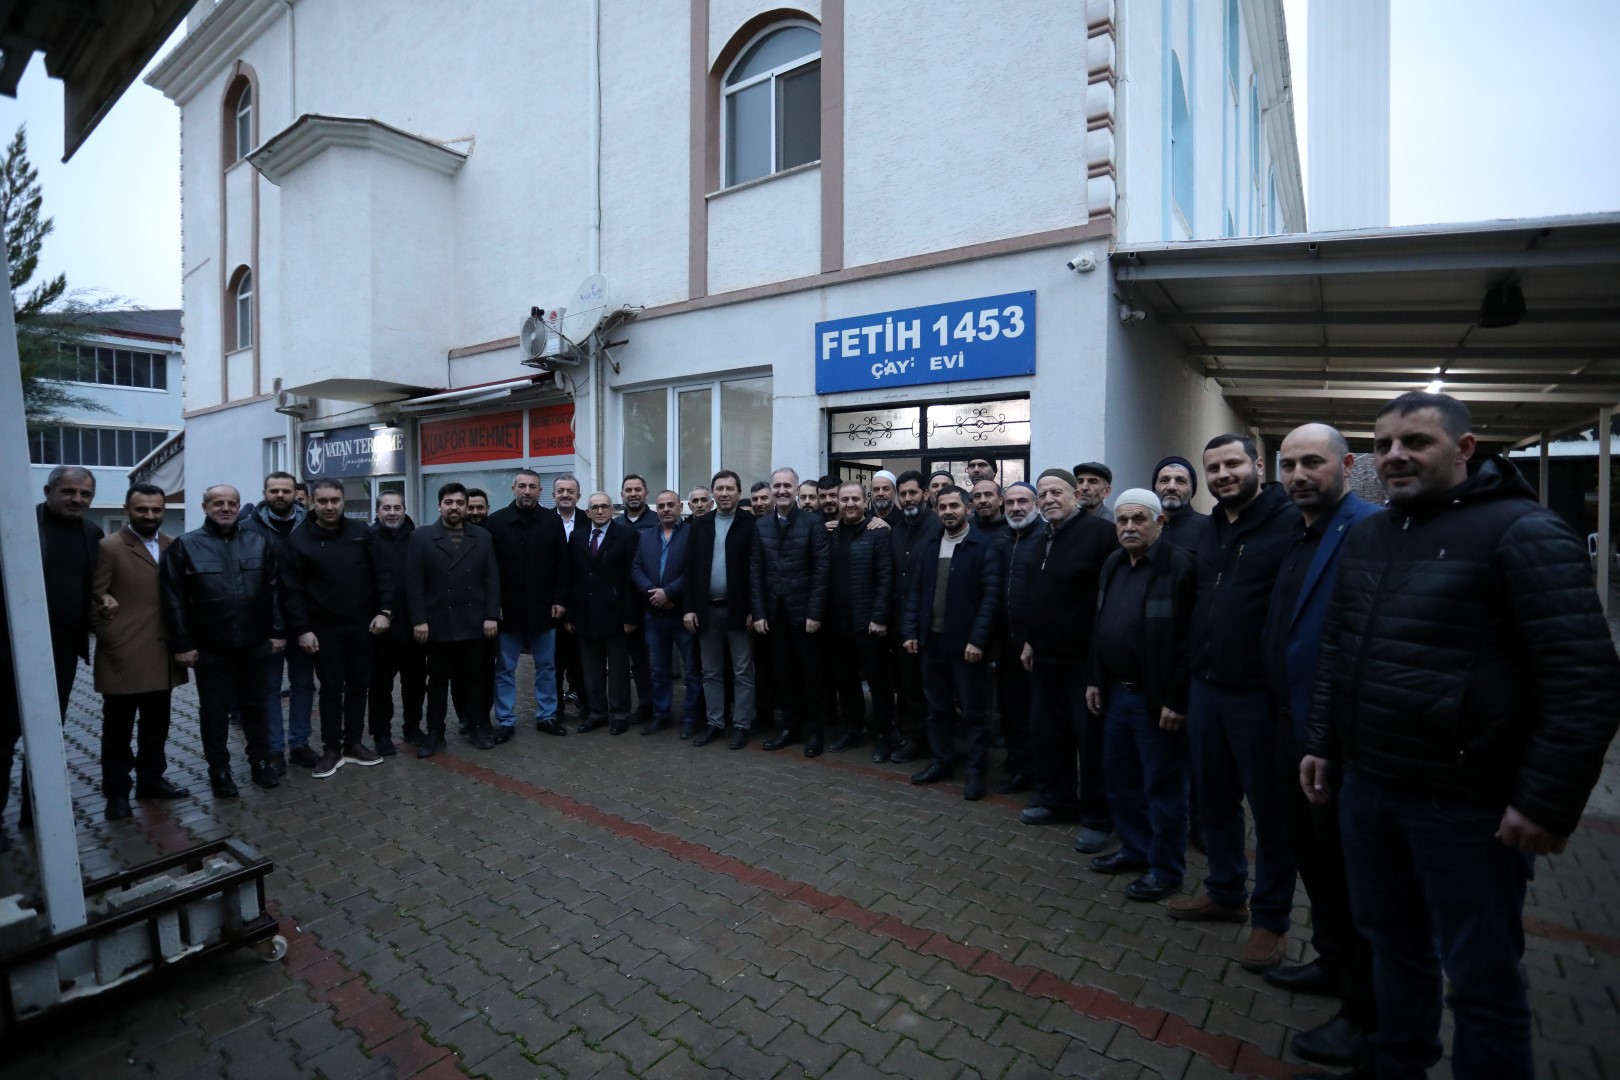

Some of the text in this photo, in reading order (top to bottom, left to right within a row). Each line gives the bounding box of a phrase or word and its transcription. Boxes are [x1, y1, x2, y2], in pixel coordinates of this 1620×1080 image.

[822, 305, 1025, 361] FETİH 1453
[929, 351, 965, 371] EVİ
[324, 433, 404, 458] VATAN TERME
[469, 422, 522, 449] MEHMET
